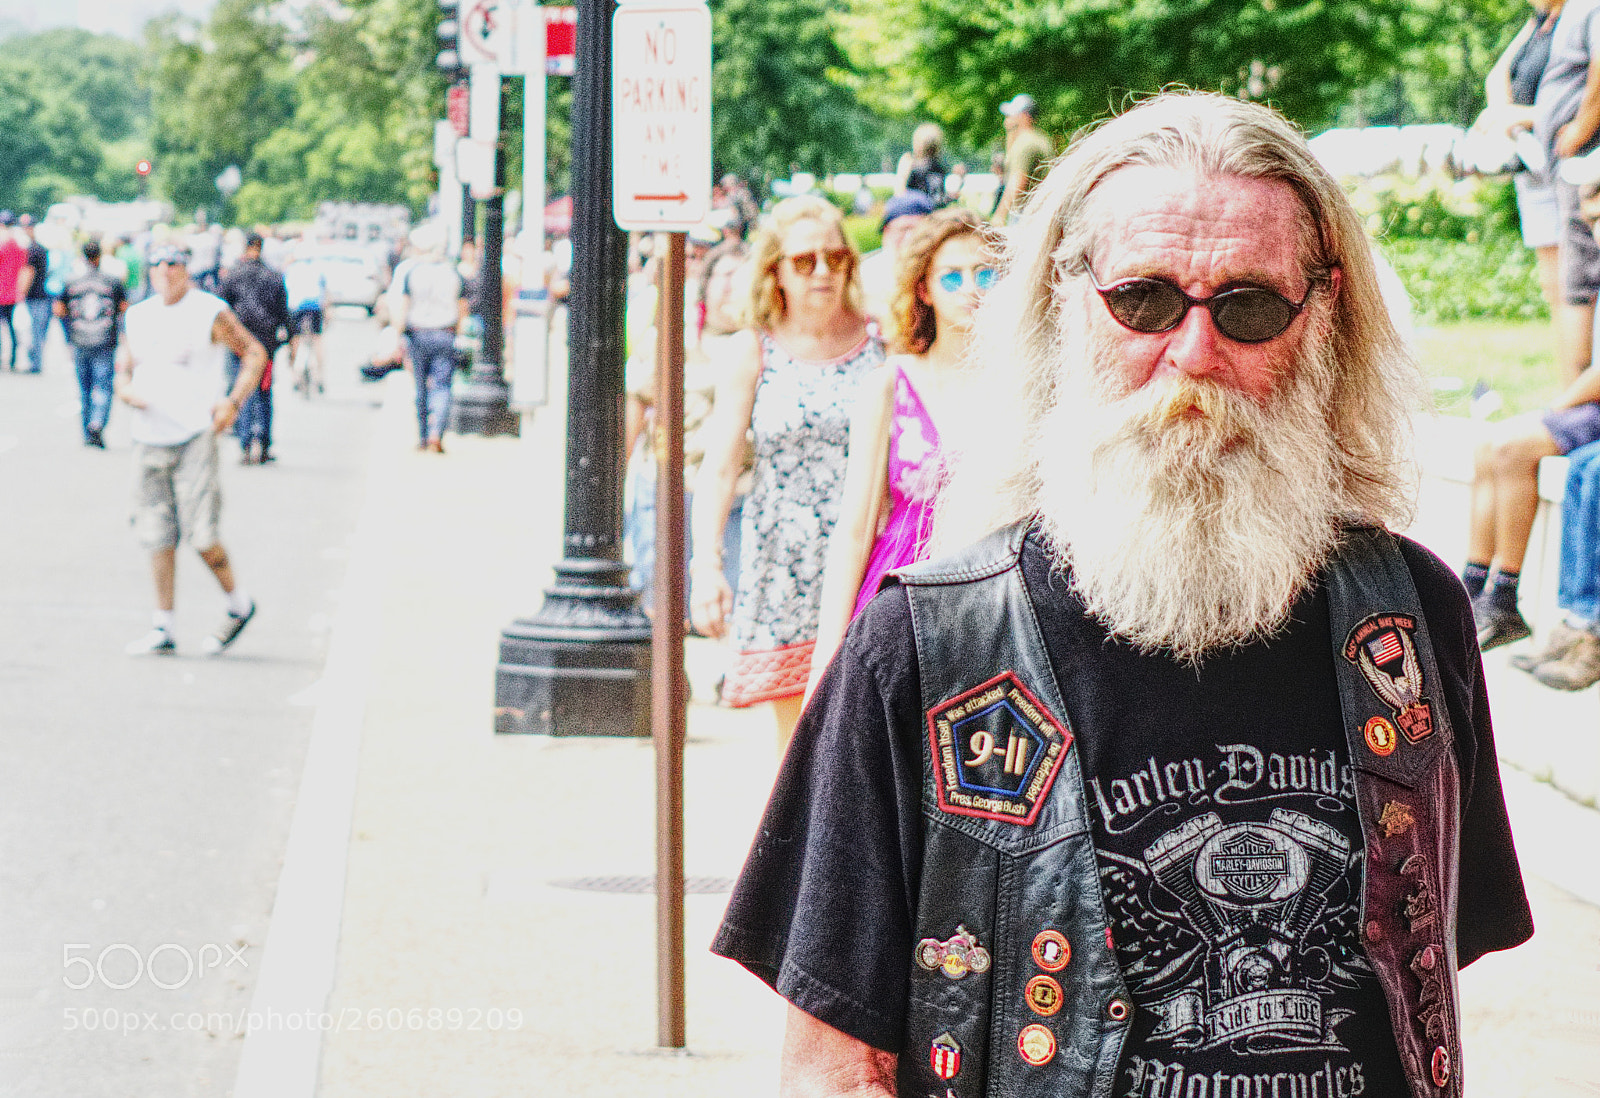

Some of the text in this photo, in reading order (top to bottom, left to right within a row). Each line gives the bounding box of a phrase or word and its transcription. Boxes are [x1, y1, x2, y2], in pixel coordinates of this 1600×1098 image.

[645, 27, 676, 65] NO
[621, 76, 699, 113] PARKING
[964, 685, 1006, 714] attacked
[1007, 687, 1059, 739] Freedom will
[941, 745, 960, 792] Freedom
[963, 727, 1029, 776] 9-11
[1025, 741, 1063, 804] be defended
[972, 795, 1005, 813] George
[1003, 799, 1028, 816] Bush
[1215, 857, 1285, 872] HARLEY-DAVIDSON
[1230, 841, 1268, 855] MOTOR
[1231, 874, 1270, 890] CYCLES
[1204, 995, 1320, 1038] Ride to Live
